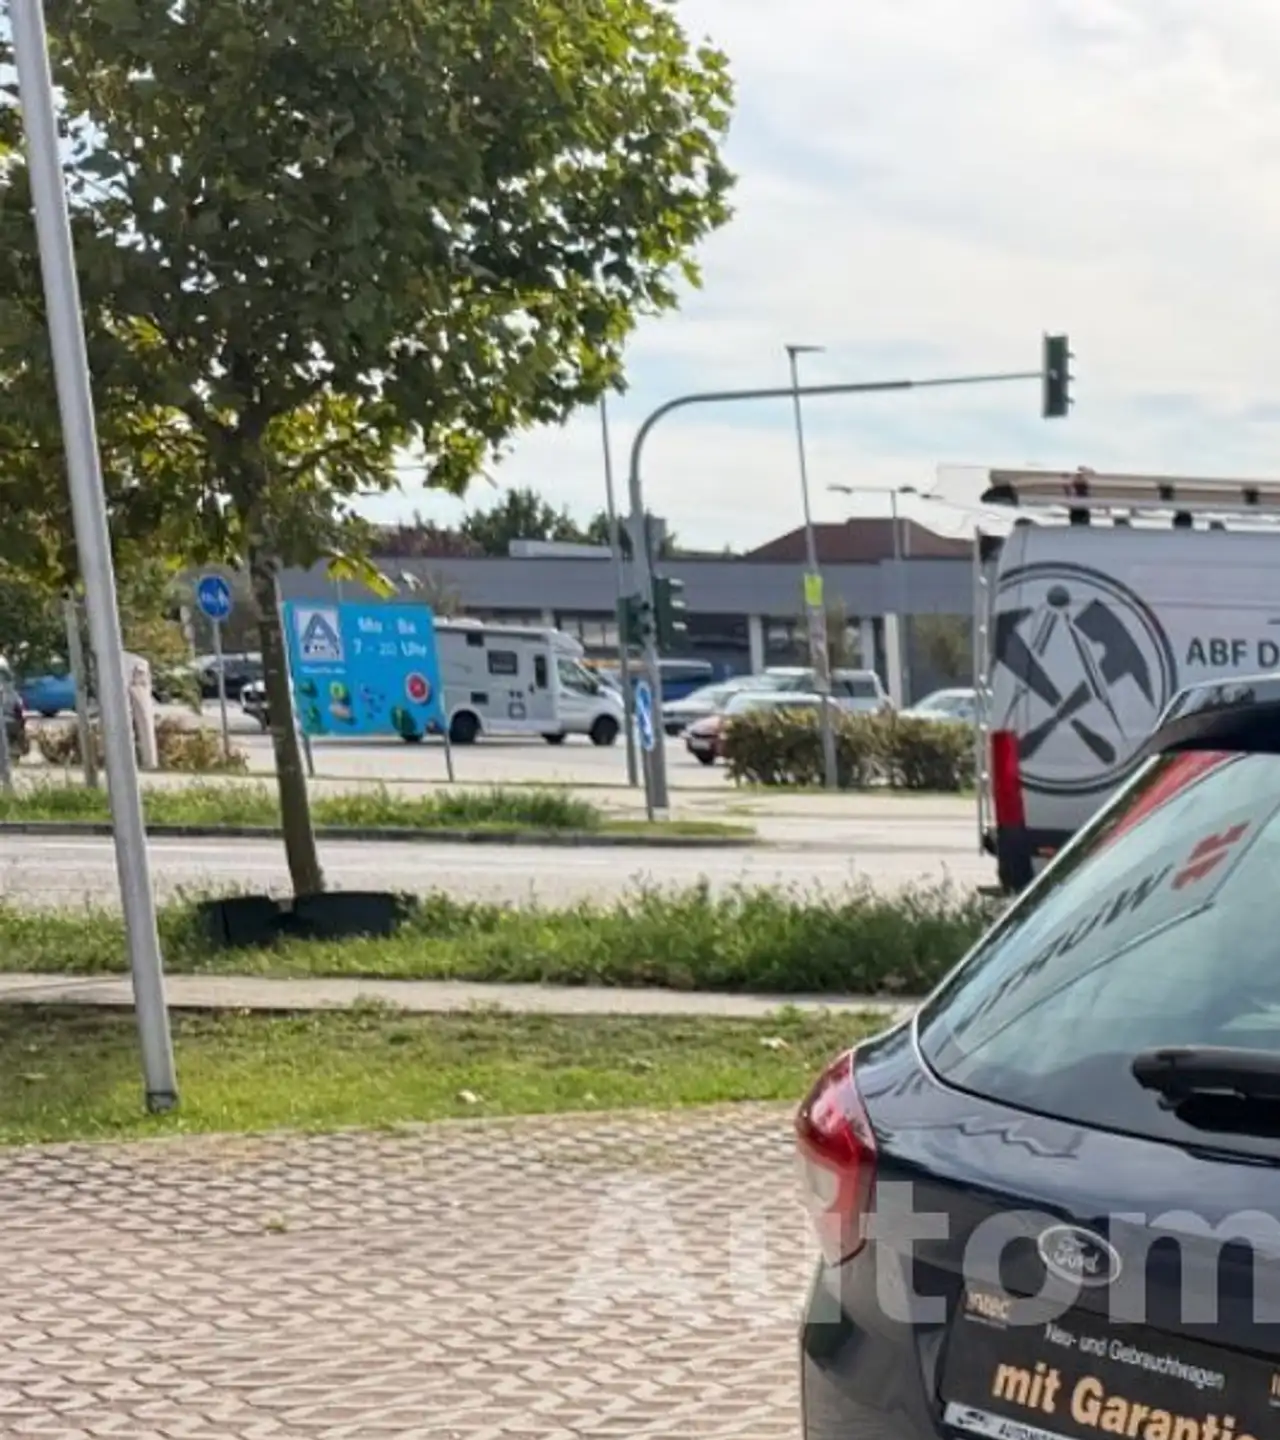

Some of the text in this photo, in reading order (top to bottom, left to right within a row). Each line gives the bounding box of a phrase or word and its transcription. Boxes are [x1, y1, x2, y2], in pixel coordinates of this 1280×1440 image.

[1186, 637, 1248, 667] ABF
[1053, 1235, 1100, 1274] Ford
[1045, 1323, 1226, 1391] Neu- und Gebrauchtwagen
[992, 1359, 1061, 1415] mit
